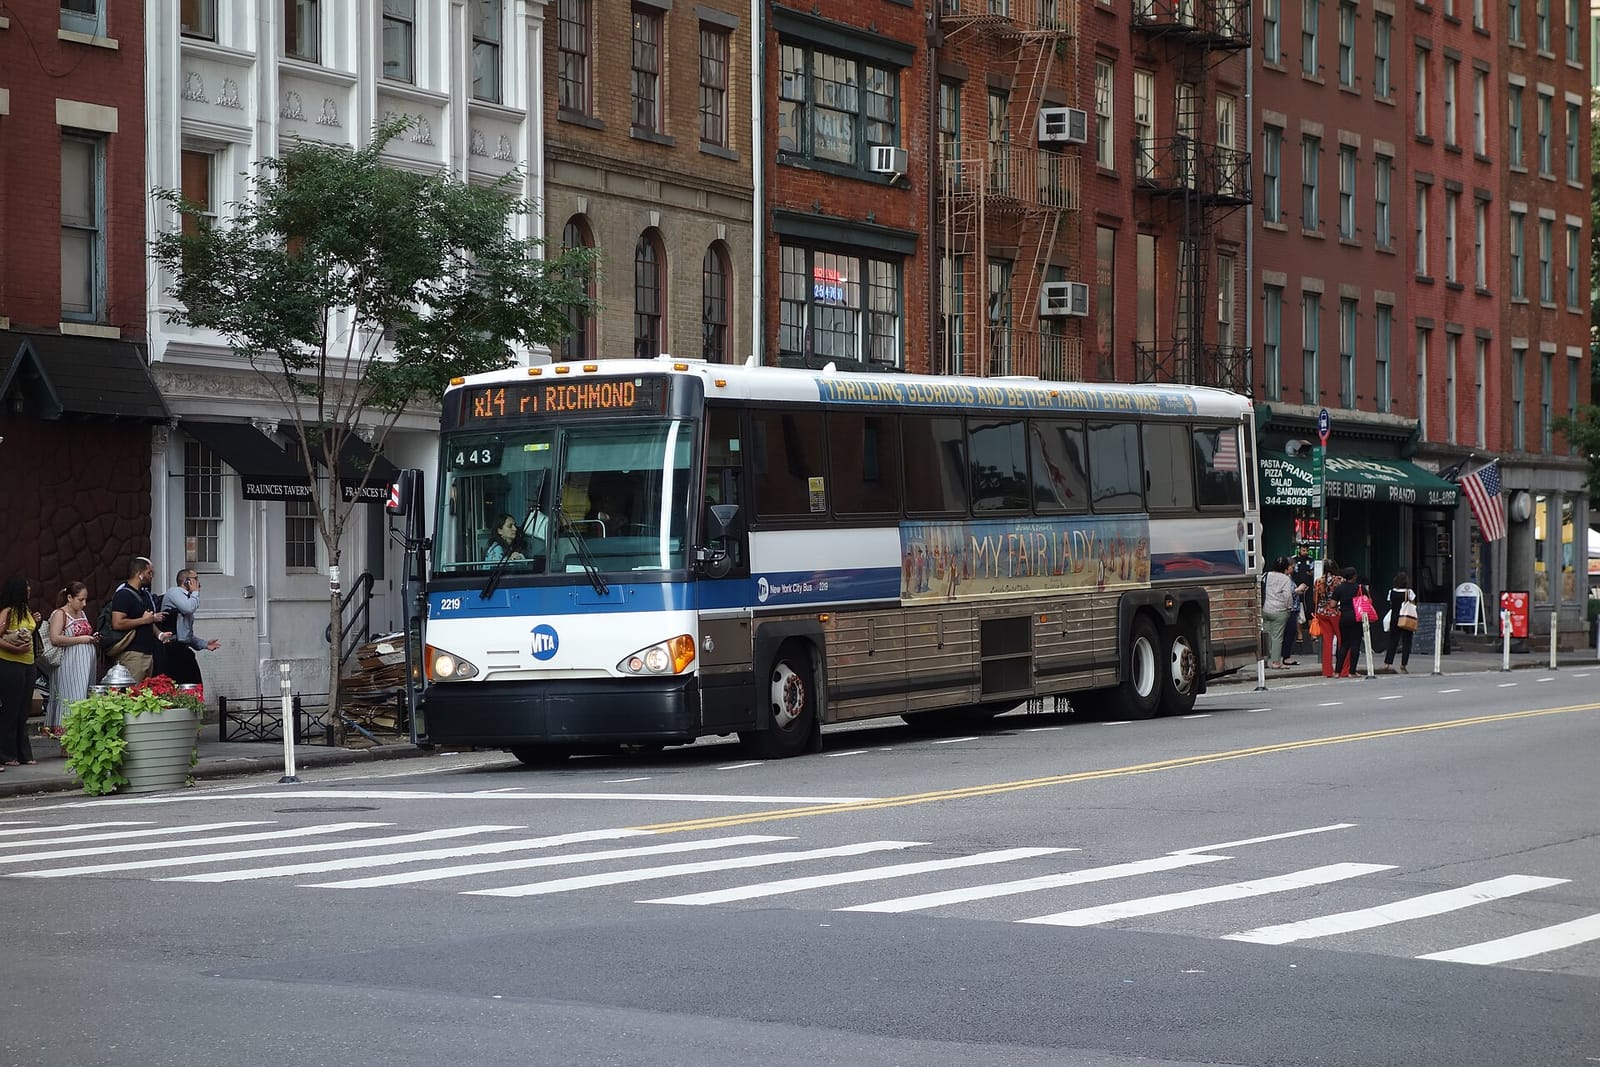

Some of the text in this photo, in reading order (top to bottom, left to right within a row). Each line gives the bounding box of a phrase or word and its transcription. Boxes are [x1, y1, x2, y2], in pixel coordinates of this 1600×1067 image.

[546, 381, 635, 411] RICHMOND
[905, 383, 975, 404] GLORIOUS
[976, 386, 1004, 406] AND
[1101, 391, 1132, 409] EVER
[1260, 459, 1281, 468] PASTA
[1264, 469, 1283, 477] PIZZA
[1270, 478, 1293, 487] SALAD
[246, 484, 283, 496] FRAUNCES
[345, 486, 379, 498] FRANCES
[1276, 487, 1314, 496] SANDWICHE
[1343, 482, 1376, 499] DELIVERY
[1389, 486, 1416, 503] PRANZO
[970, 529, 1096, 579] MY FAIR LADY
[769, 584, 781, 594] New
[781, 584, 792, 593] York
[792, 583, 802, 595] City
[803, 583, 813, 592] Bus
[441, 599, 460, 610] 2219
[530, 632, 555, 653] MTA
